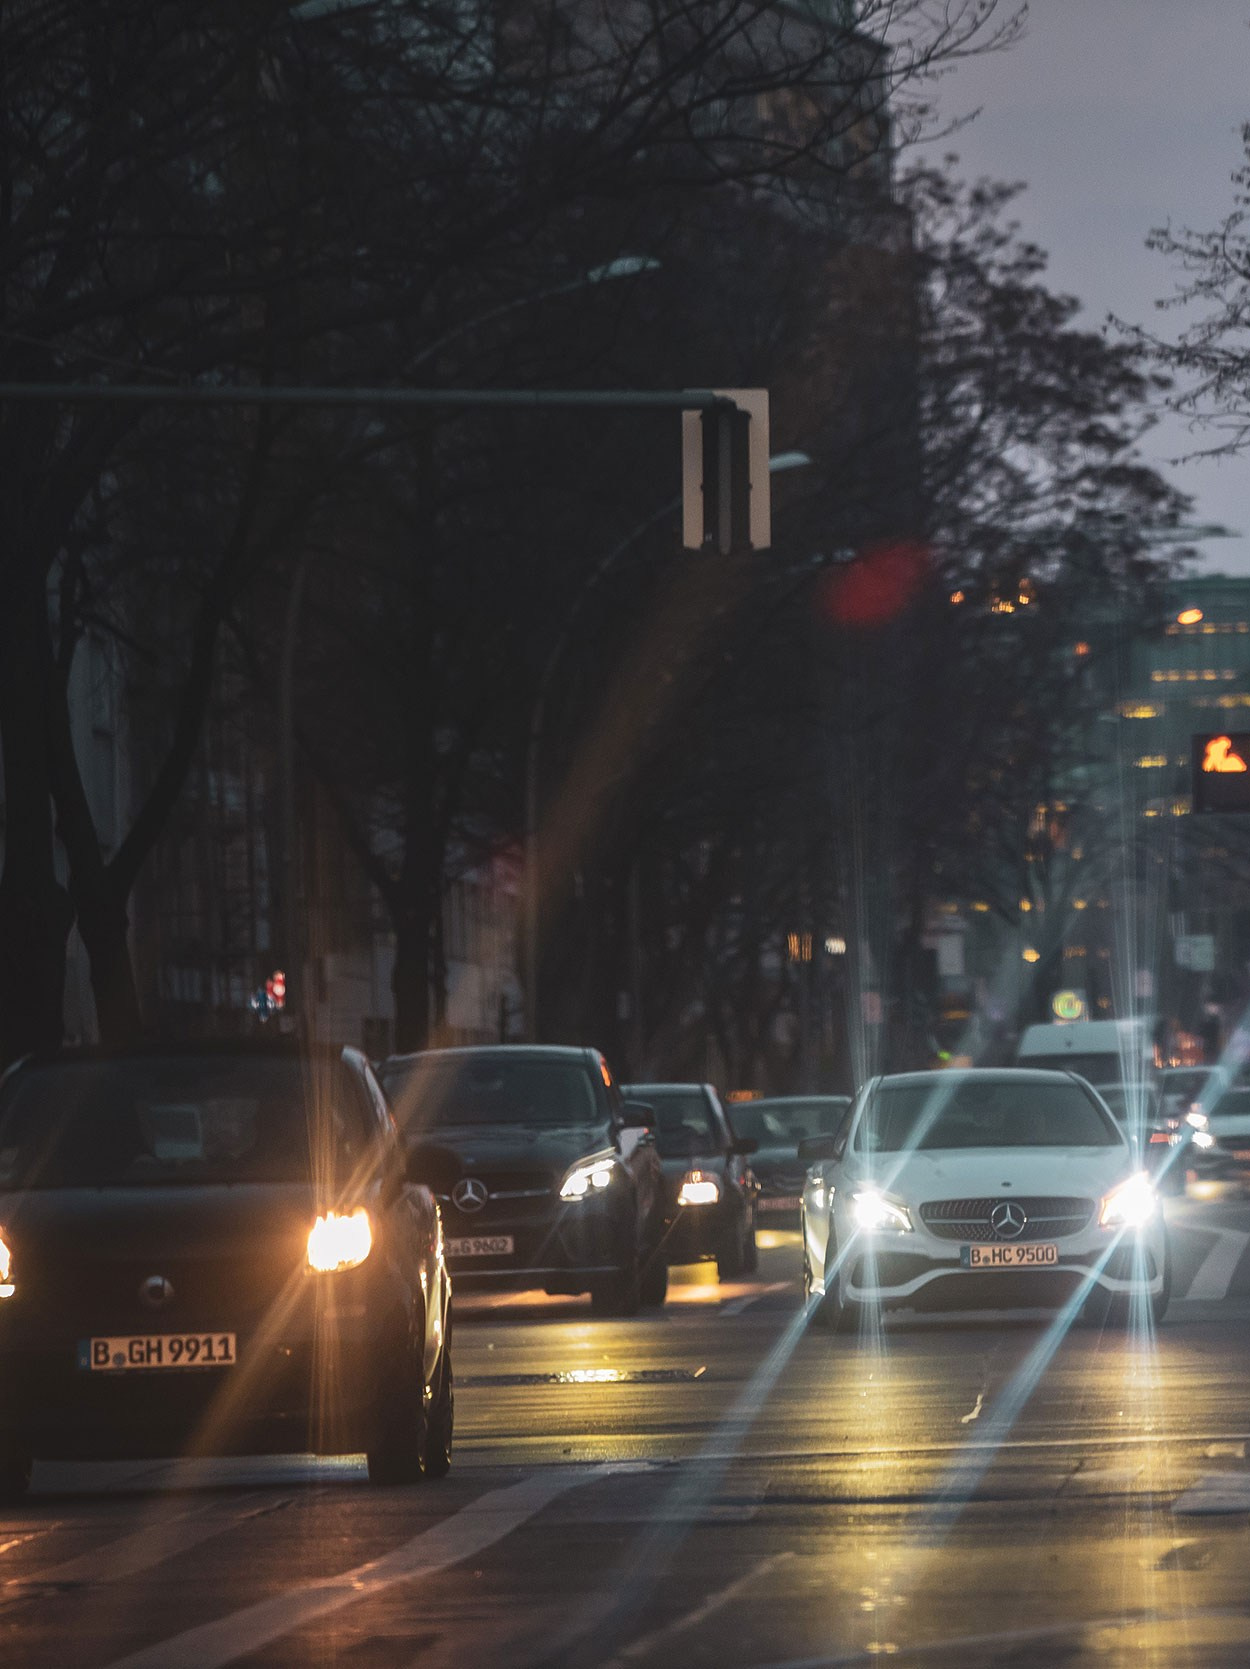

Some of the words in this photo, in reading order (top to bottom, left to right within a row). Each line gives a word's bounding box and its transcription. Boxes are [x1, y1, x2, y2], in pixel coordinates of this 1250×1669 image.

[992, 1247, 1013, 1263] HC
[1016, 1246, 1055, 1263] 9500
[93, 1341, 110, 1366] B
[128, 1339, 163, 1365] GH
[169, 1336, 233, 1363] 9911
